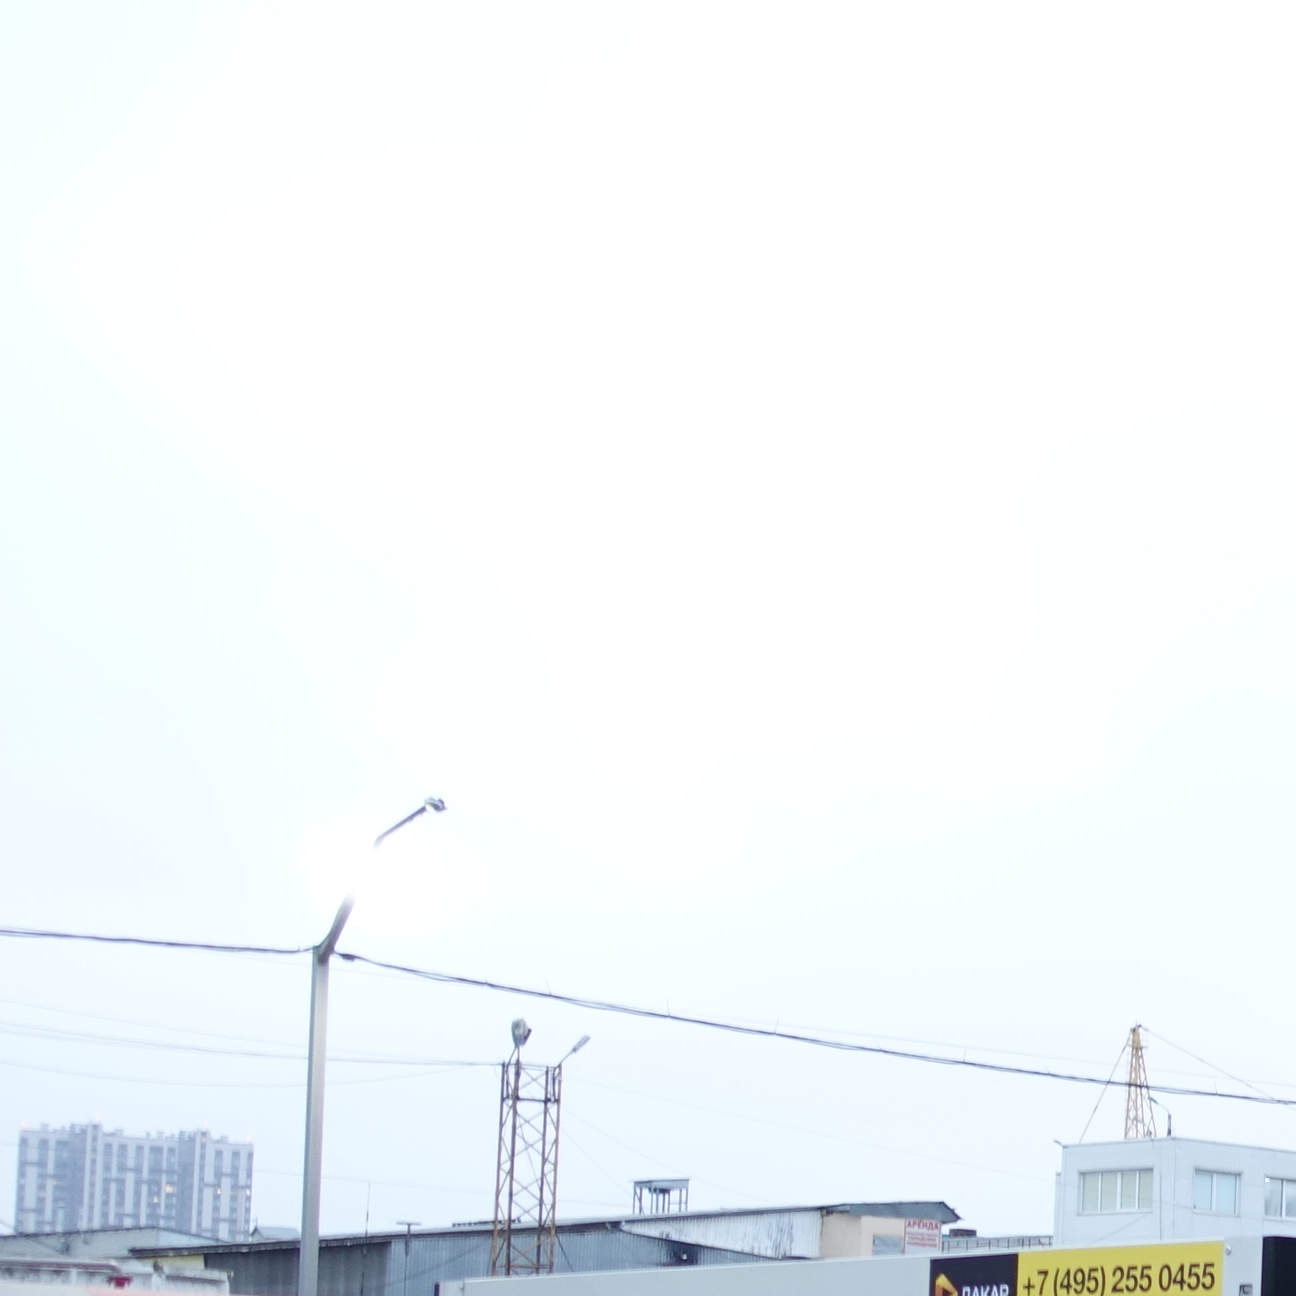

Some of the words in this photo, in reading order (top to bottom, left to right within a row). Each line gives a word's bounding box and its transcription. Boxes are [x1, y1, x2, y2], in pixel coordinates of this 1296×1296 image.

[907, 1220, 939, 1231] АРЕНДА
[1022, 1270, 1049, 1296] +7
[1111, 1265, 1152, 1295] 255
[1158, 1263, 1215, 1292] 0455
